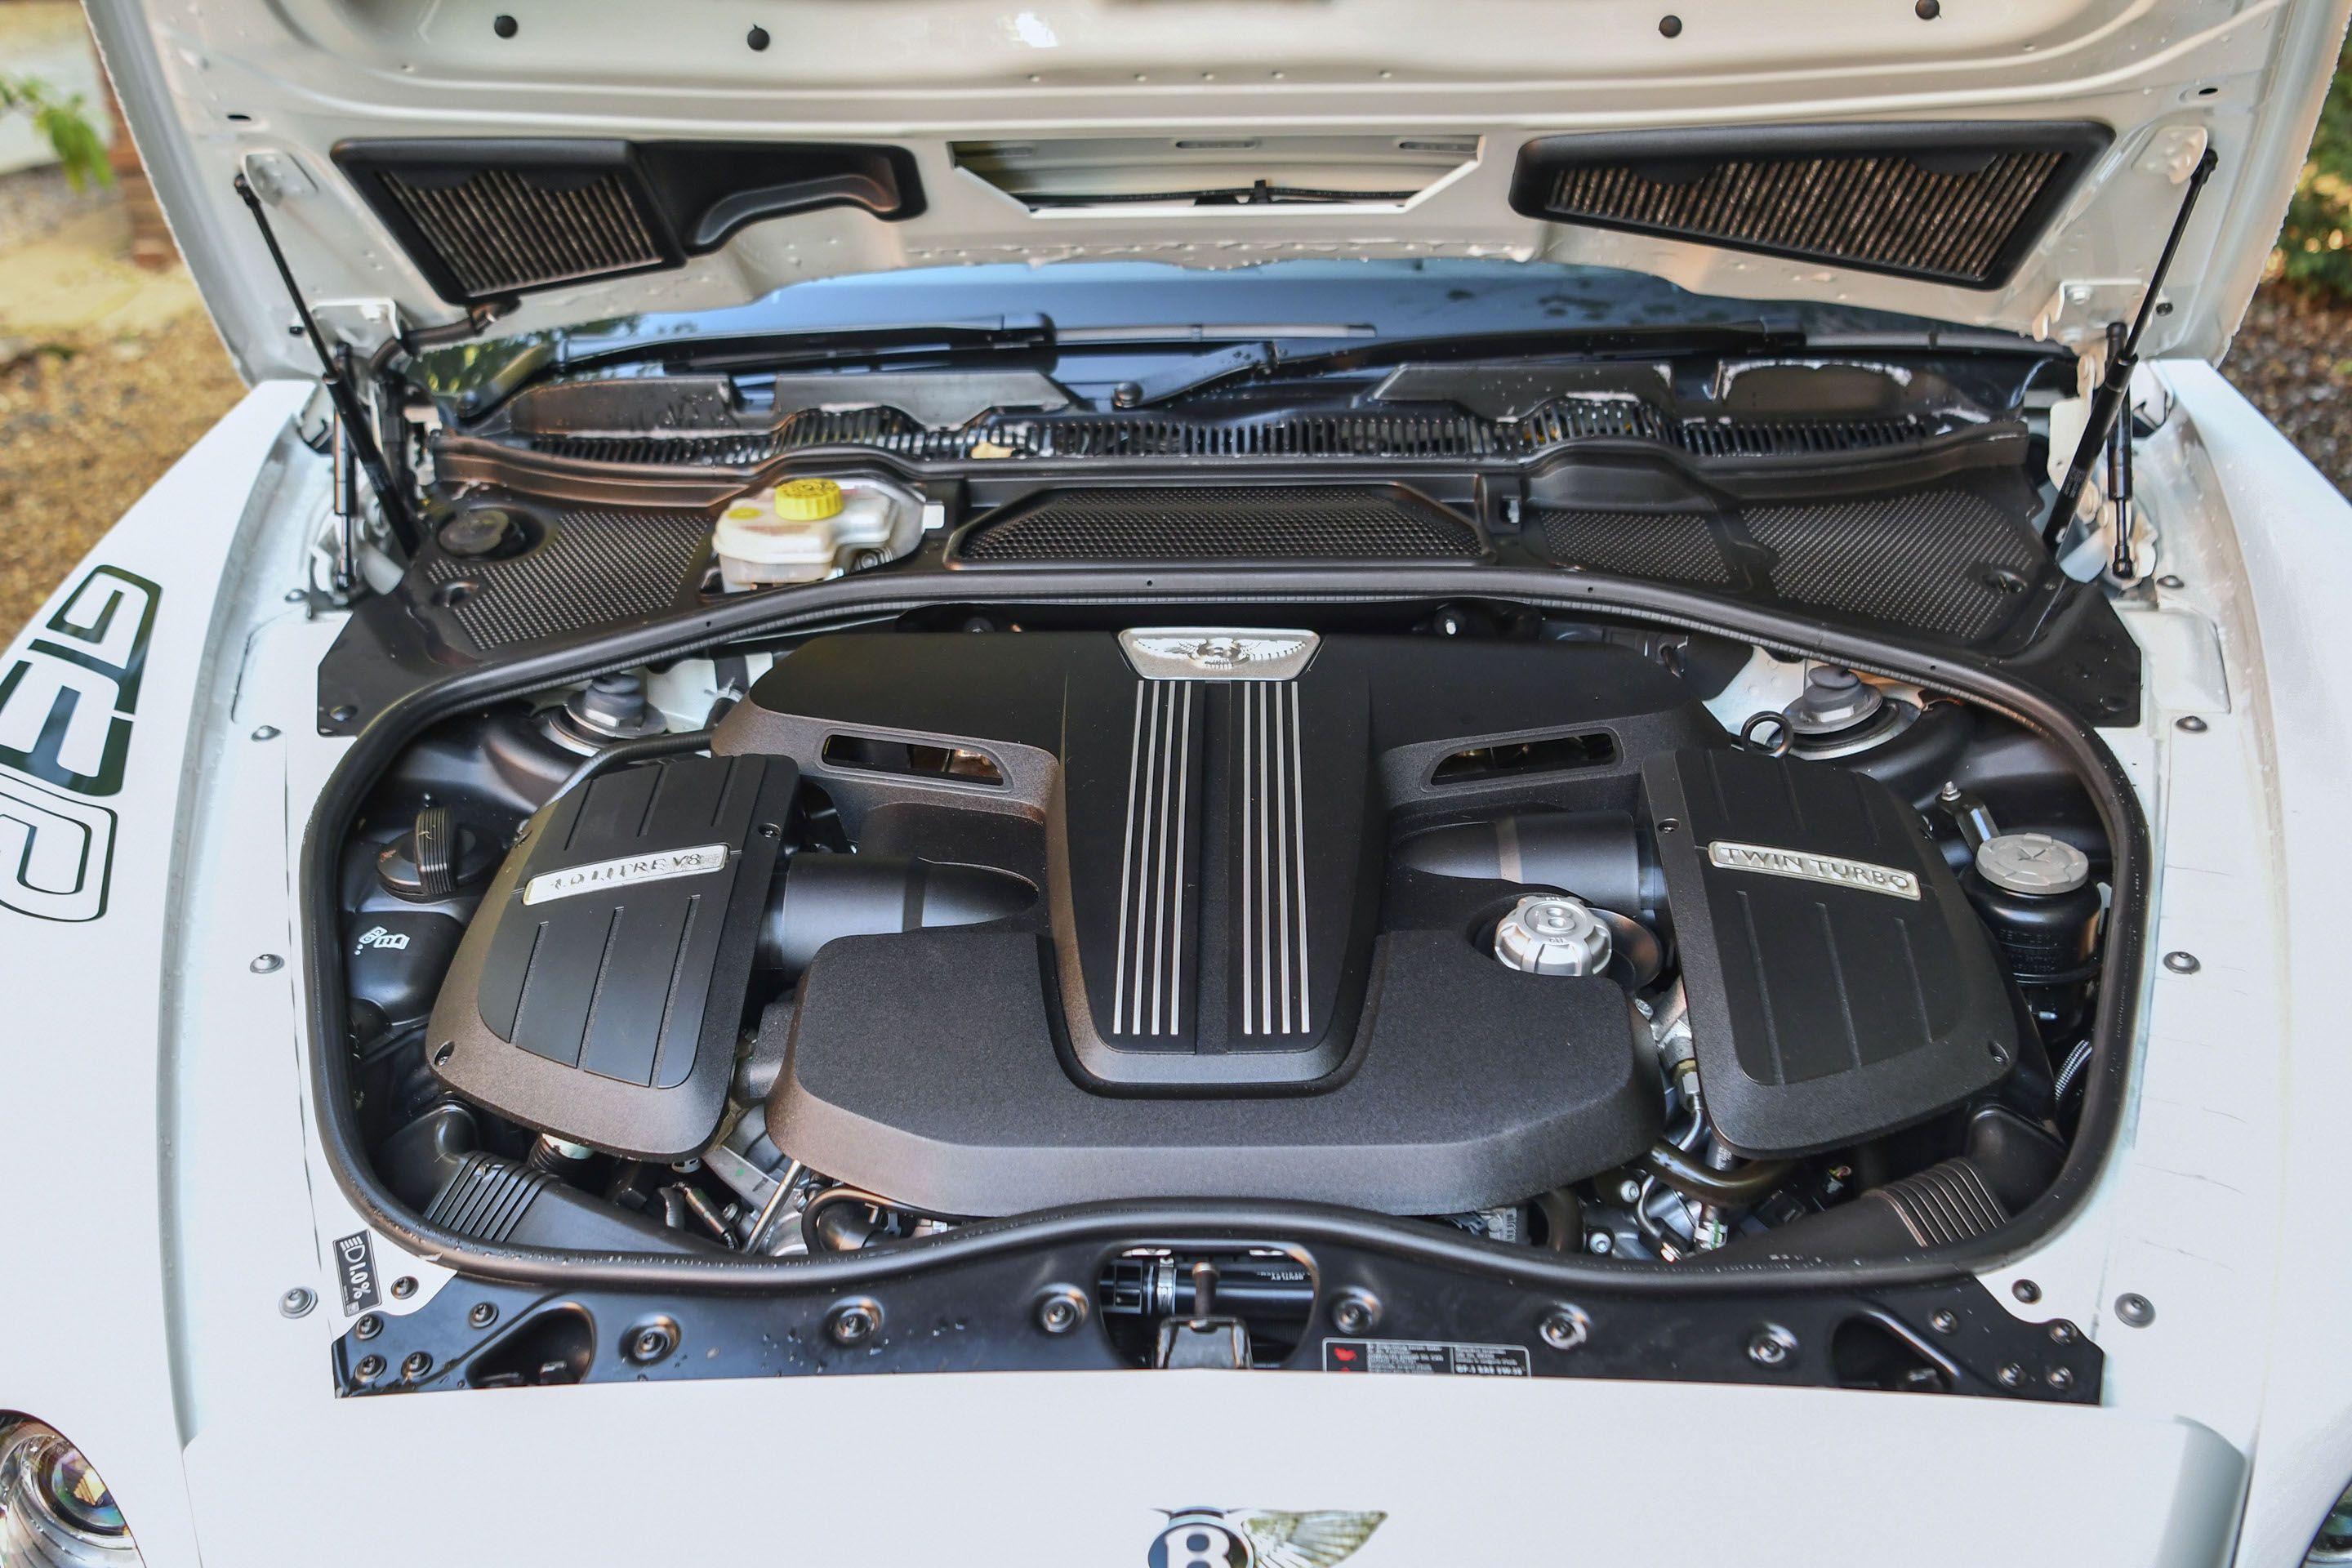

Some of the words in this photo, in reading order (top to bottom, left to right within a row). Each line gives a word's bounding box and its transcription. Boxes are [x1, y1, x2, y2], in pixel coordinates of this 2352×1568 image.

[590, 858, 666, 883] LITRE
[672, 853, 702, 869] V8
[1721, 847, 1804, 871] TWIN
[1811, 859, 1909, 889] TURBO
[363, 929, 384, 942] G12
[349, 1261, 372, 1300] 1.0%
[1165, 1523, 1232, 1568] B
